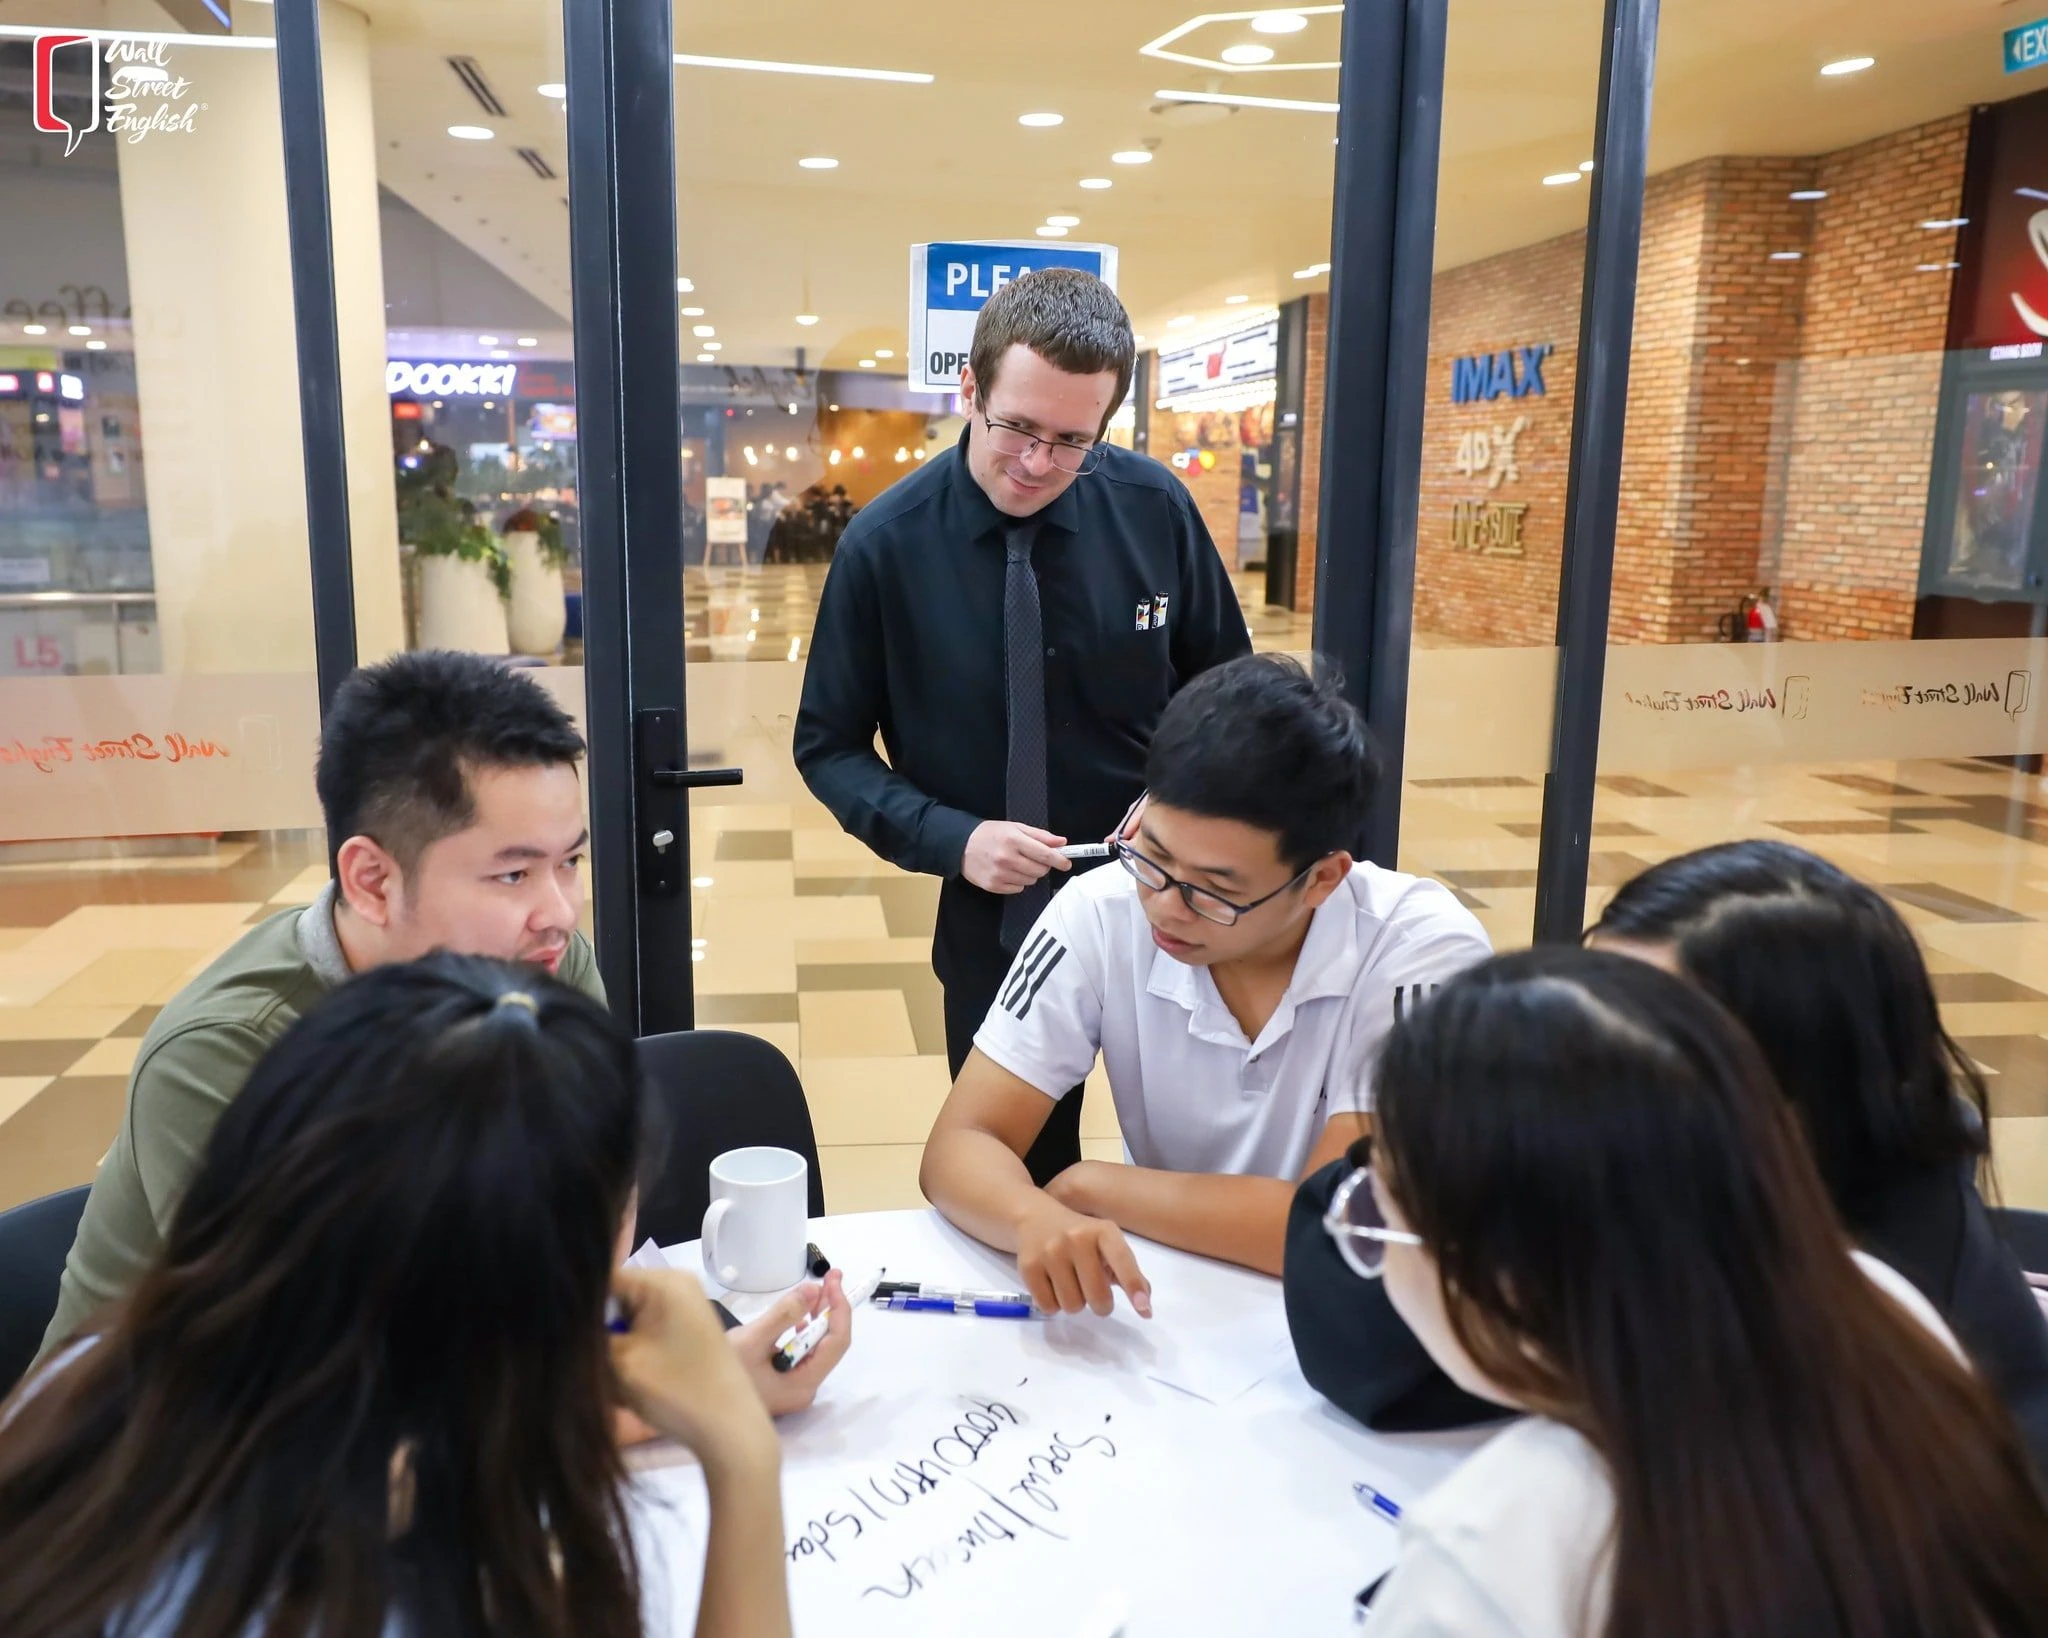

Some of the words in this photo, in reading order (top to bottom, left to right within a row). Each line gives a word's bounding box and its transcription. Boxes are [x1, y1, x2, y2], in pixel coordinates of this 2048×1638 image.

[946, 262, 1082, 298] PLE
[386, 361, 517, 396] DOOKKI
[1452, 345, 1547, 404] IMAX
[1456, 416, 1526, 489] 4DX
[14, 634, 61, 669] L5
